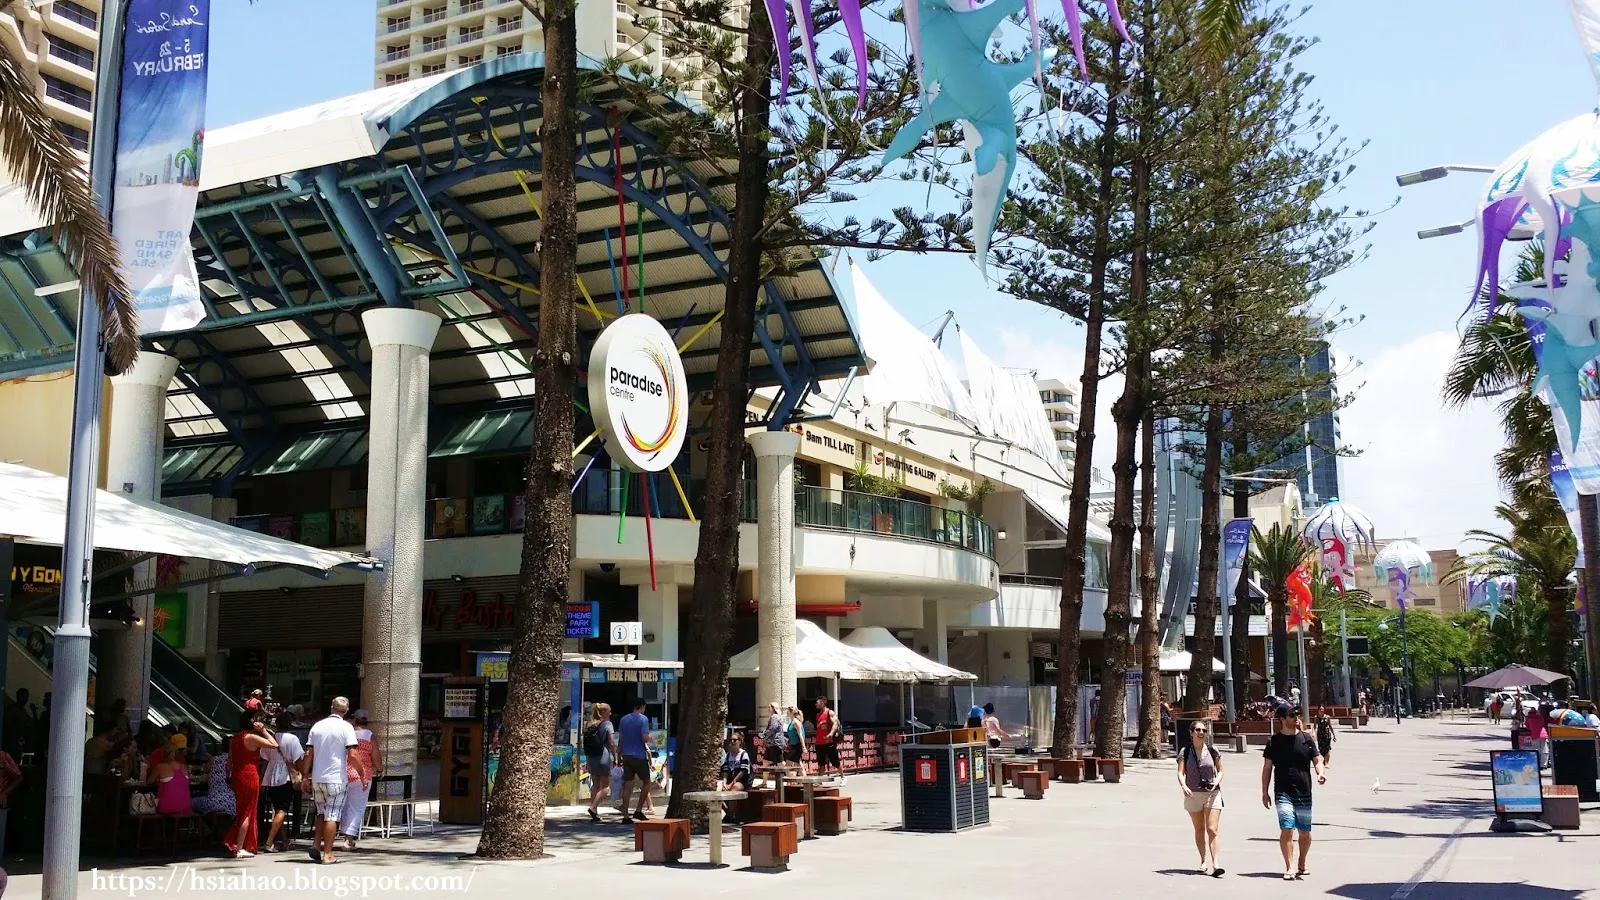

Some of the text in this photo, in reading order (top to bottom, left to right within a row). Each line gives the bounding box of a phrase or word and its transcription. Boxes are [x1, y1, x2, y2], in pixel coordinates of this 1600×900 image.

[610, 366, 663, 397] paradise
[609, 385, 636, 402] centre
[805, 429, 855, 455] 9am TILL LATE
[885, 455, 937, 482] SHOOTING GALLERY
[566, 627, 592, 635] TICKETS
[481, 662, 507, 672] SC
[607, 669, 624, 682] THEME
[624, 669, 638, 682] PARK
[638, 669, 658, 682] TICKETS
